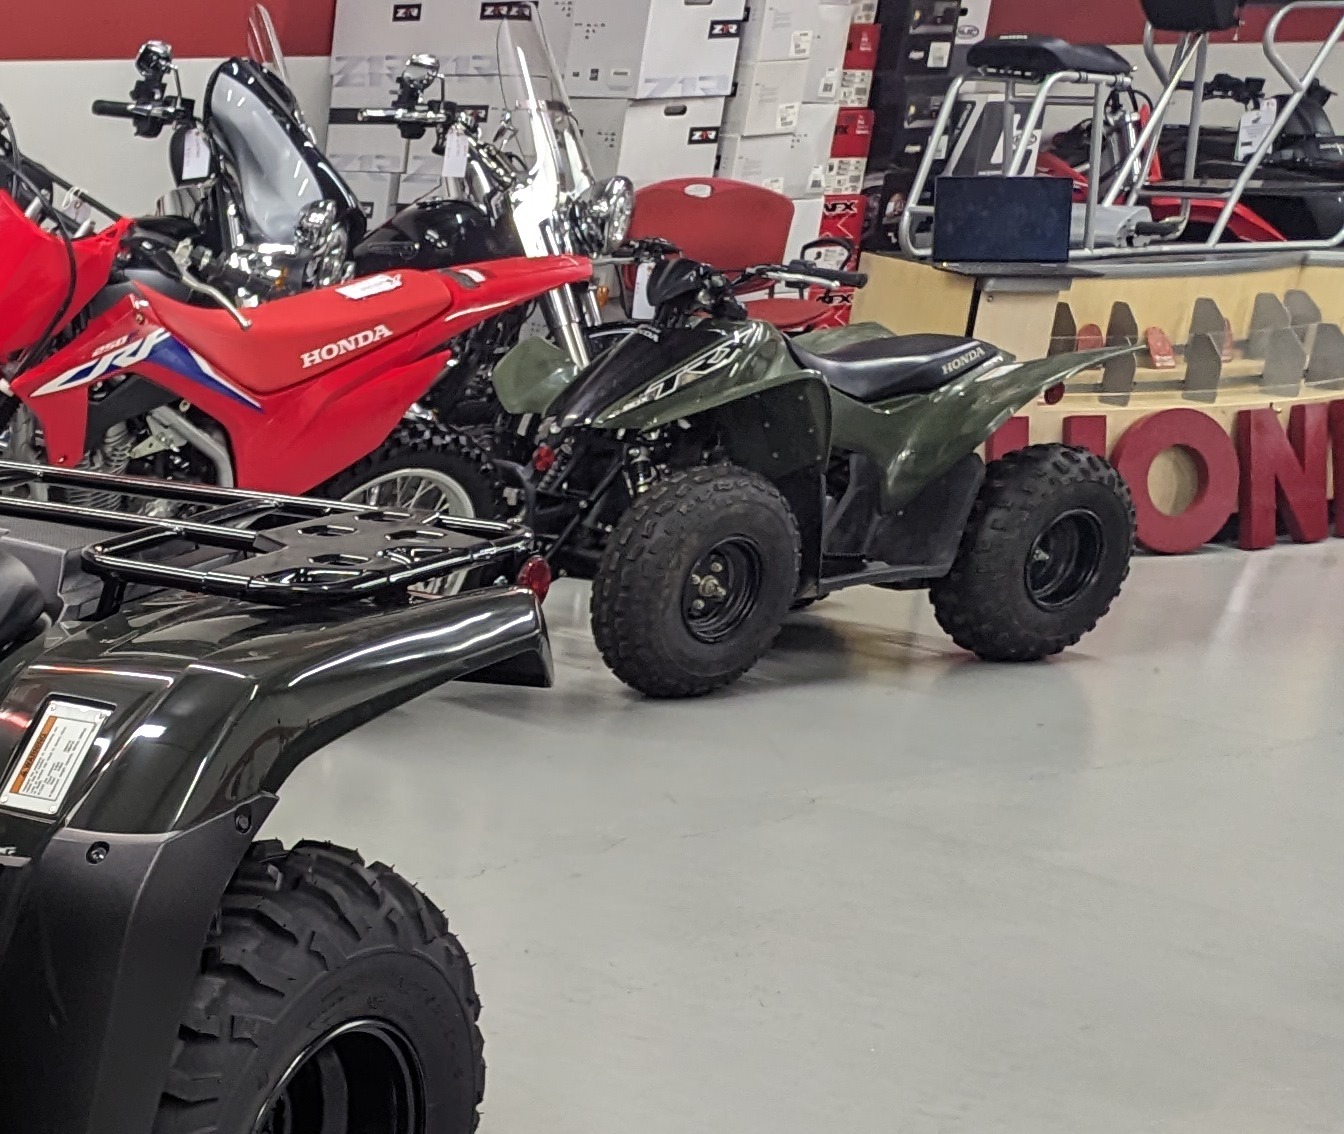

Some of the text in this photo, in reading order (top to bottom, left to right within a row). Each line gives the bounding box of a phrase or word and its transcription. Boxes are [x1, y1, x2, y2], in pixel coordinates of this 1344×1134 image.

[713, 23, 738, 34] Z1R
[29, 326, 172, 398] CRF
[300, 324, 394, 369] HONDA
[941, 346, 986, 375] HONDA
[986, 400, 1344, 554] ON
